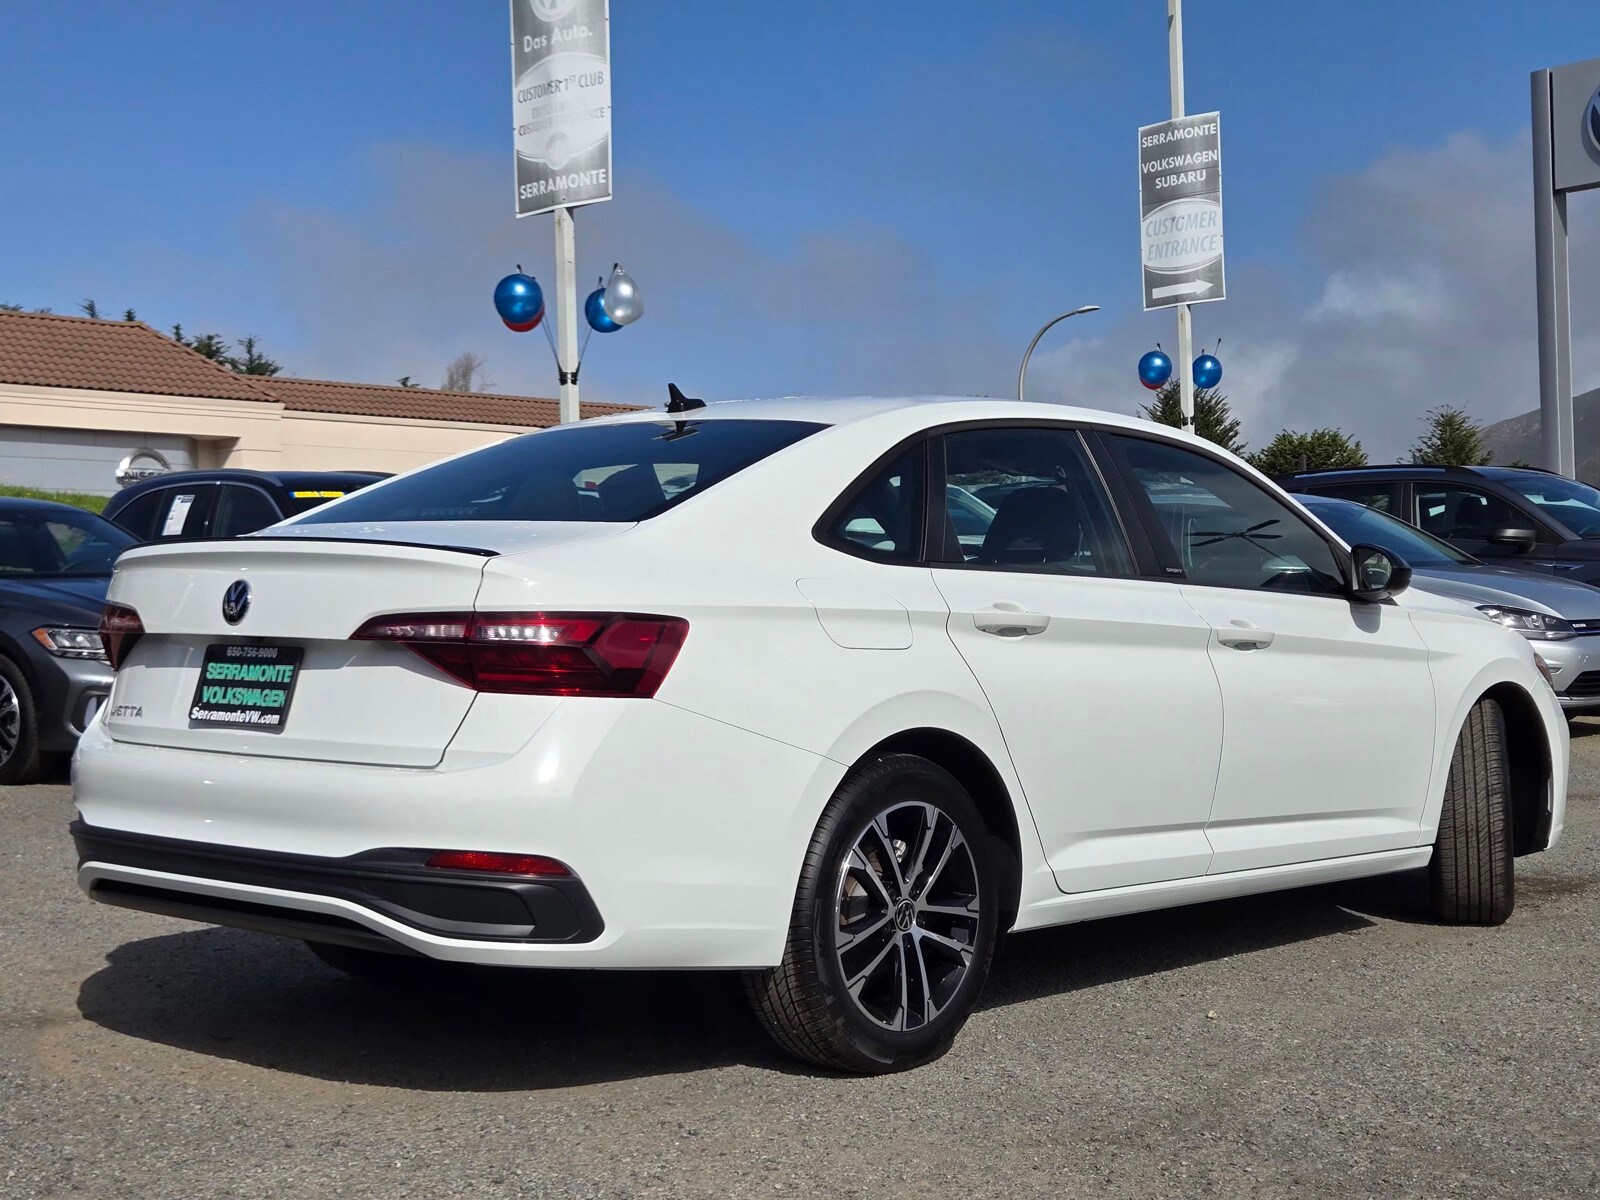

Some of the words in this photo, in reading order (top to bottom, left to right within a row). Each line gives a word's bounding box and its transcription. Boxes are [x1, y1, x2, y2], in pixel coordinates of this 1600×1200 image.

[523, 35, 547, 53] Das
[551, 26, 593, 43] Auto.
[518, 79, 562, 104] CUSTOMER
[578, 71, 604, 88] CLUB
[1142, 123, 1217, 148] SERRAMONTE
[1142, 150, 1218, 174] VOLKSWAGEN
[520, 169, 607, 199] SERRAMONTE
[1155, 169, 1207, 189] SUBARU
[1146, 210, 1217, 238] CUSTOMER
[1147, 234, 1217, 262] ENTRANCE
[226, 646, 279, 658] 650-756-9000
[206, 662, 295, 683] SERRAMONTE
[202, 685, 288, 707] VOLKSWAGEN
[111, 704, 143, 718] JETTA
[190, 706, 281, 725] SerramonteVW.com
